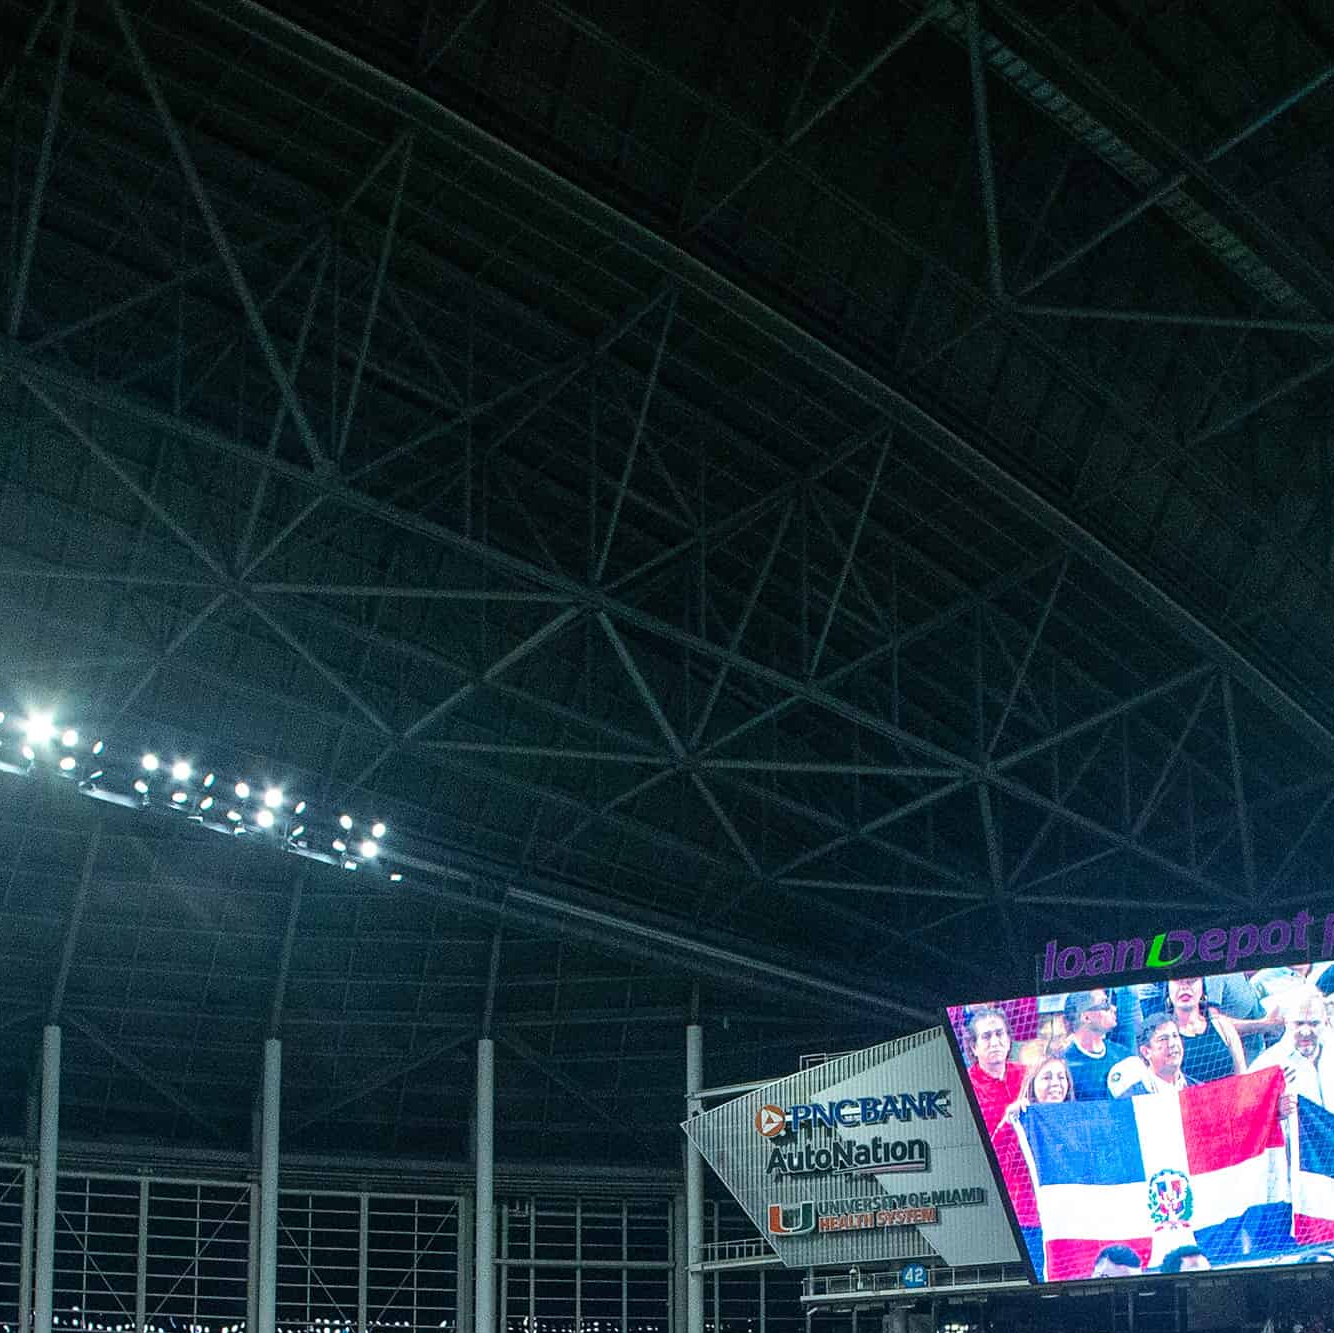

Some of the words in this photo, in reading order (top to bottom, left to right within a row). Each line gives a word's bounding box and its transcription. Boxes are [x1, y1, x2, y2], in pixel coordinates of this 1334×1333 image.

[1043, 911, 1314, 981] loanDepot
[767, 1137, 927, 1174] AutoNation
[818, 1194, 904, 1216] UNIVERSITY
[931, 1187, 986, 1206] MIAMI
[818, 1211, 874, 1233] HEALTH
[875, 1207, 937, 1228] SYSTEM
[906, 1267, 924, 1282] 42
